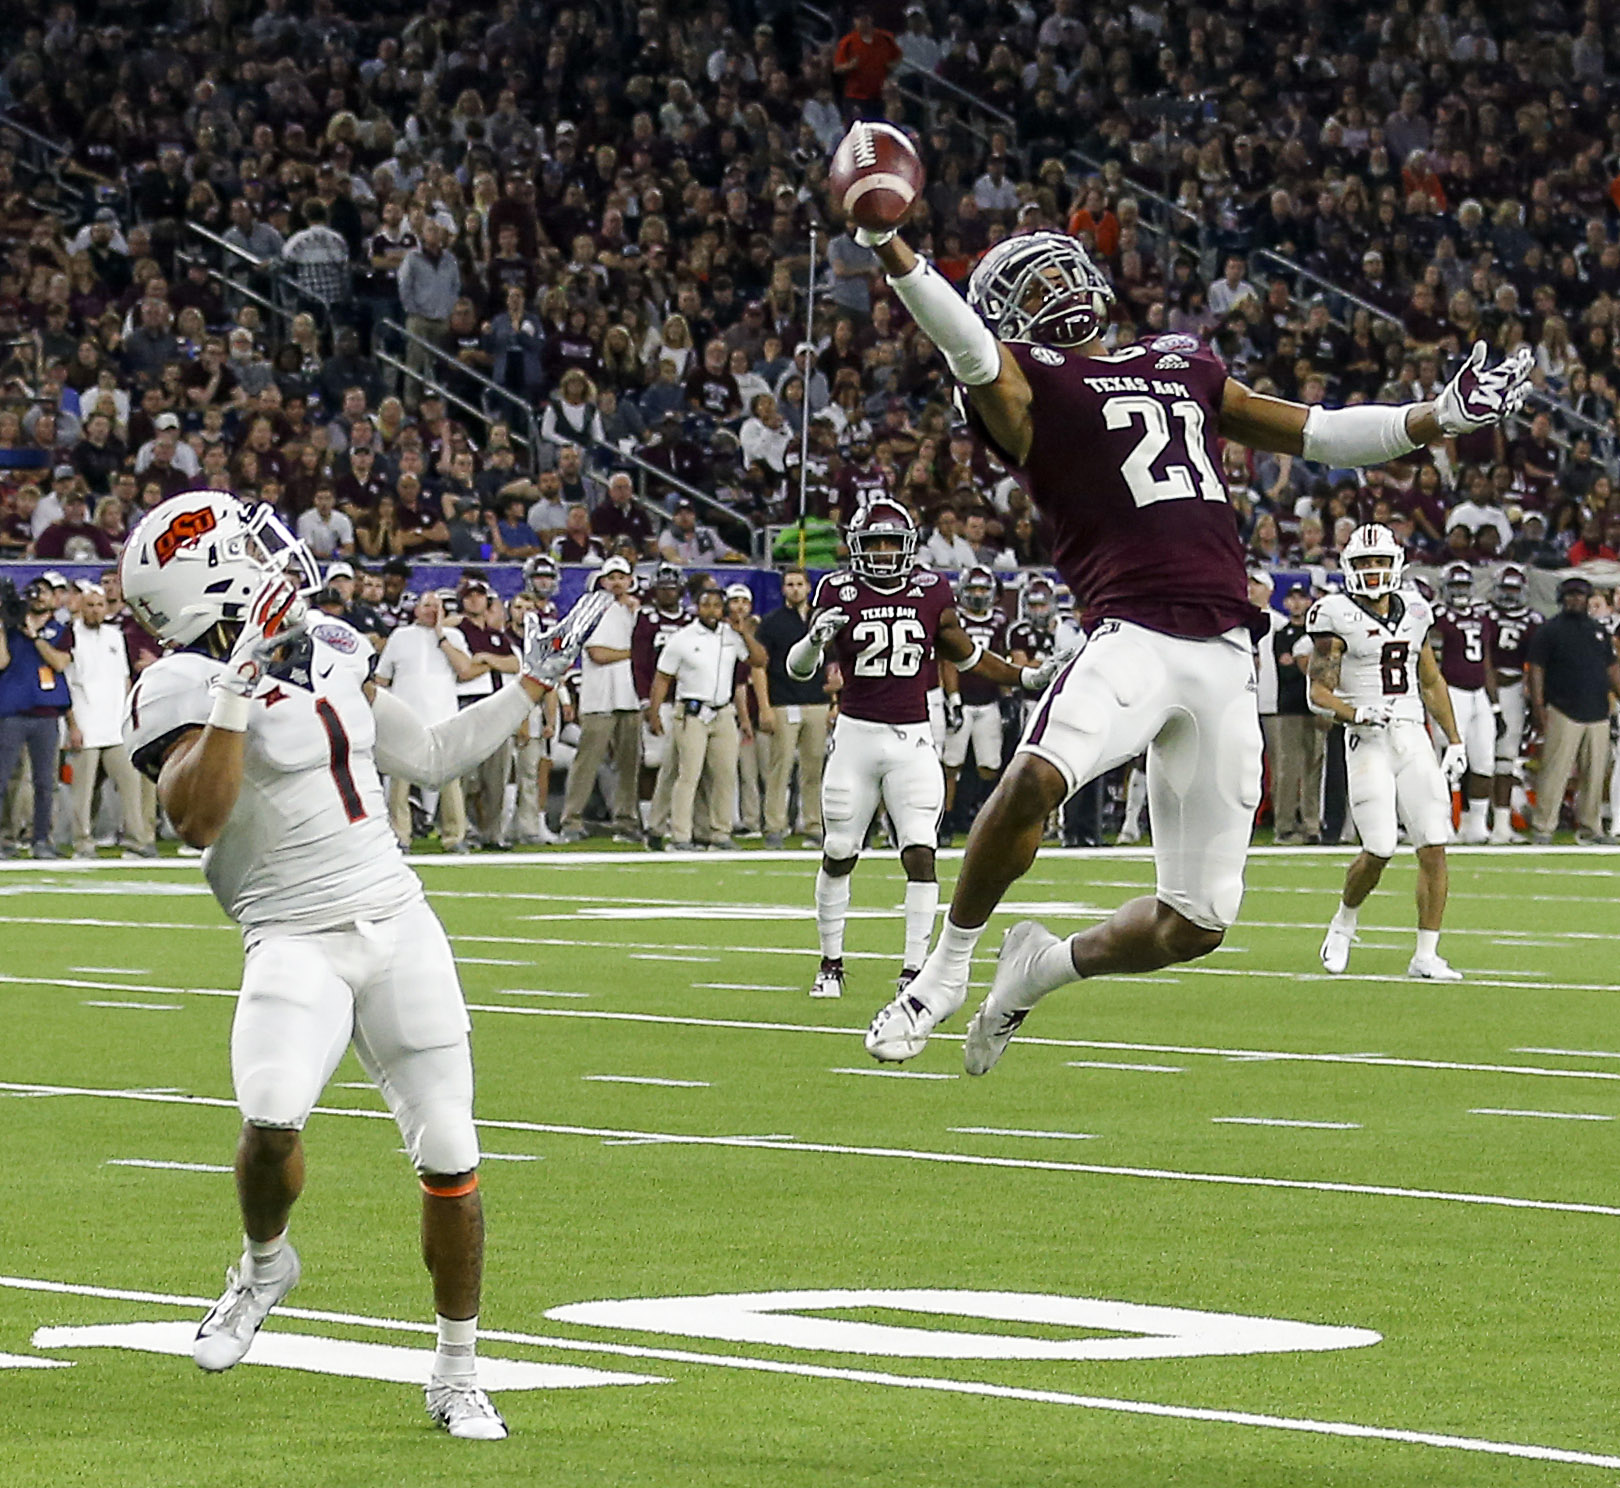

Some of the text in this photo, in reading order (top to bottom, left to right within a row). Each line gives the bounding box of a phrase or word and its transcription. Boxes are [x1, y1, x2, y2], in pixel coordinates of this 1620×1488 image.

[1083, 377, 1150, 394] TEXAS
[1101, 395, 1228, 508] 21
[860, 607, 895, 620] TEXAS
[852, 619, 926, 677] 26
[1380, 640, 1411, 696] 8
[1464, 628, 1483, 662] 5
[315, 696, 369, 824] 1
